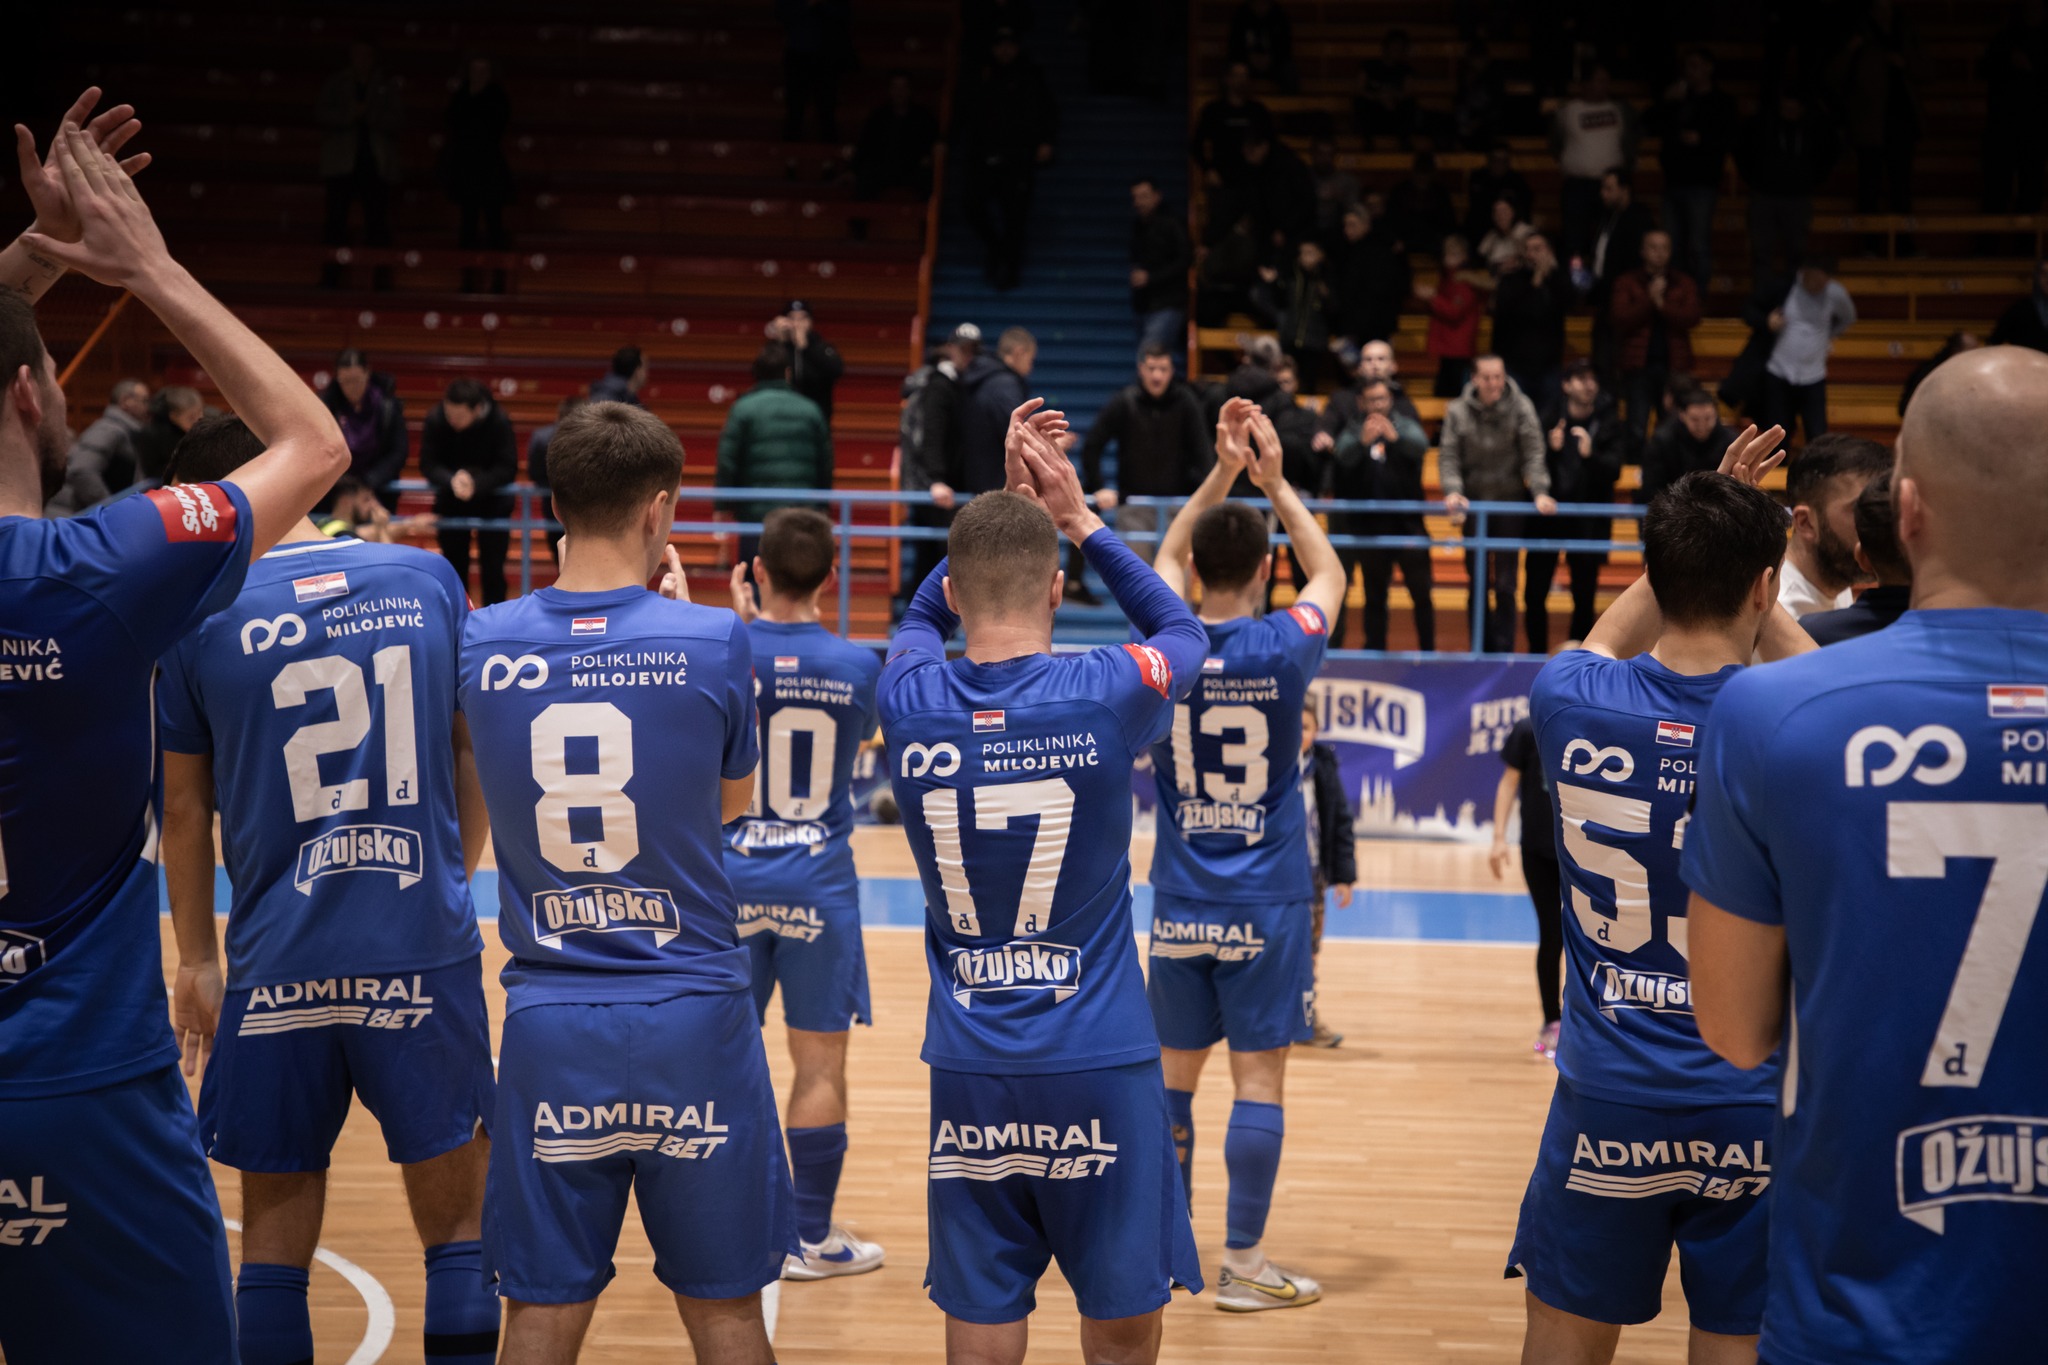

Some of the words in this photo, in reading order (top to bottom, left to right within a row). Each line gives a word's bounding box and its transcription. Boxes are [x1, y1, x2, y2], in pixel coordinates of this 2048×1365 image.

[322, 597, 422, 621] POLIKLINIKA
[325, 612, 424, 638] MILOJEVIĆ
[571, 652, 688, 669] POLIKLINIKA
[572, 668, 687, 687] MILOJEVIĆ
[775, 676, 854, 693] POLIKLINIKA
[1319, 685, 1407, 737] jsko
[1470, 695, 1530, 732] FUTS
[271, 644, 418, 823] 21
[983, 732, 1096, 755] POLIKLINIKA
[984, 749, 1099, 772] MILOJEVIĆ
[1171, 703, 1269, 805] 13
[530, 702, 640, 873] 8
[307, 829, 411, 876] Ožujsko
[922, 777, 1075, 936] 17
[544, 888, 665, 929] Ožujsko
[737, 903, 825, 927] MIRAL
[1153, 916, 1265, 945] ADMIRAL
[1887, 801, 2048, 1088] 7
[957, 945, 1070, 985] Ožujsko
[1216, 946, 1264, 961] BET
[246, 975, 433, 1010] ADMIRAL
[366, 1007, 433, 1029] BET
[533, 1101, 728, 1134] ADMIRAL
[658, 1134, 728, 1159] BET
[933, 1119, 1117, 1152] ADMIRAL
[1048, 1153, 1117, 1179] BET
[1573, 1133, 1771, 1172] ADMIRAL
[1702, 1176, 1771, 1201] BET
